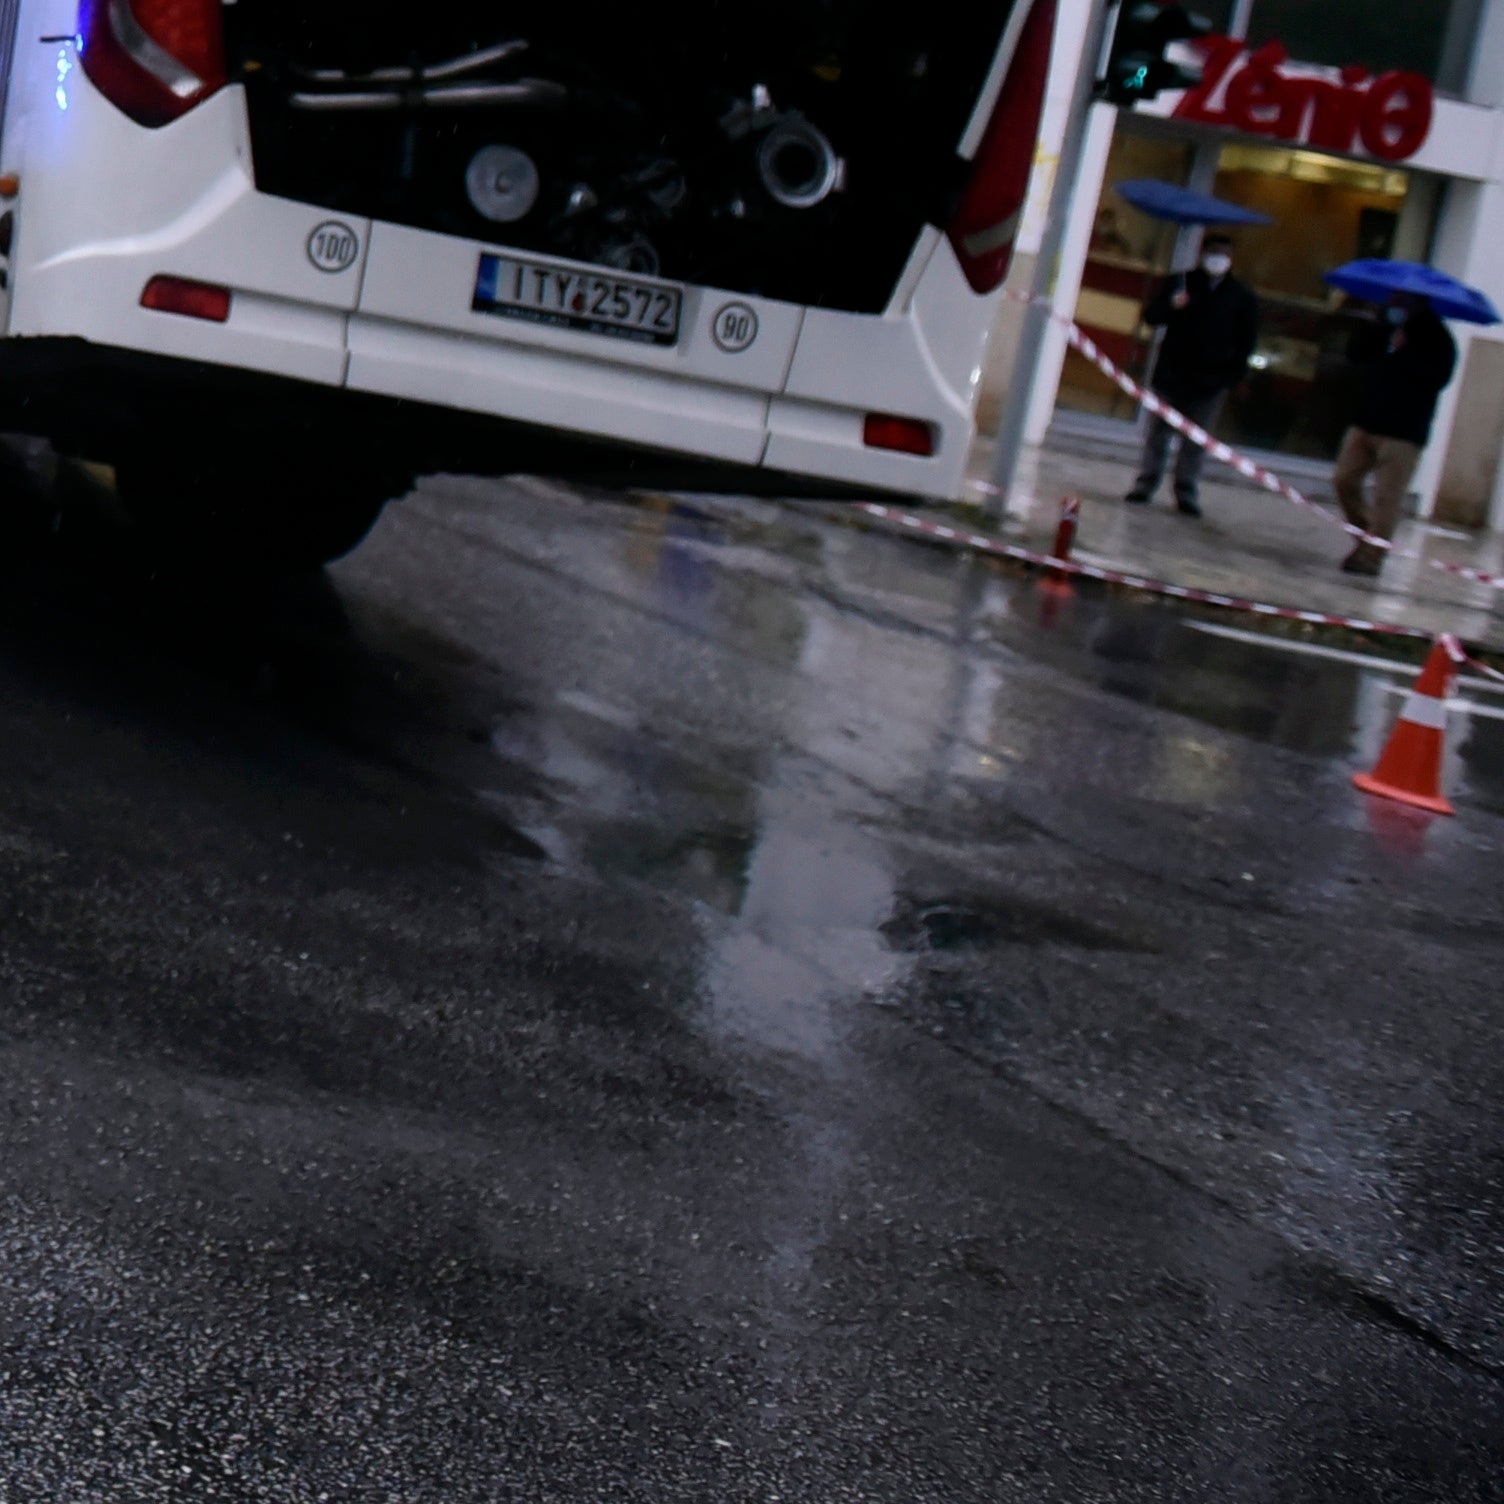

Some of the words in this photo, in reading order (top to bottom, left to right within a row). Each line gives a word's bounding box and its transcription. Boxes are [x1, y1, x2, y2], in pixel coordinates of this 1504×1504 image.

[316, 233, 352, 264] 100
[592, 282, 673, 328] 2572
[723, 312, 749, 341] 90
